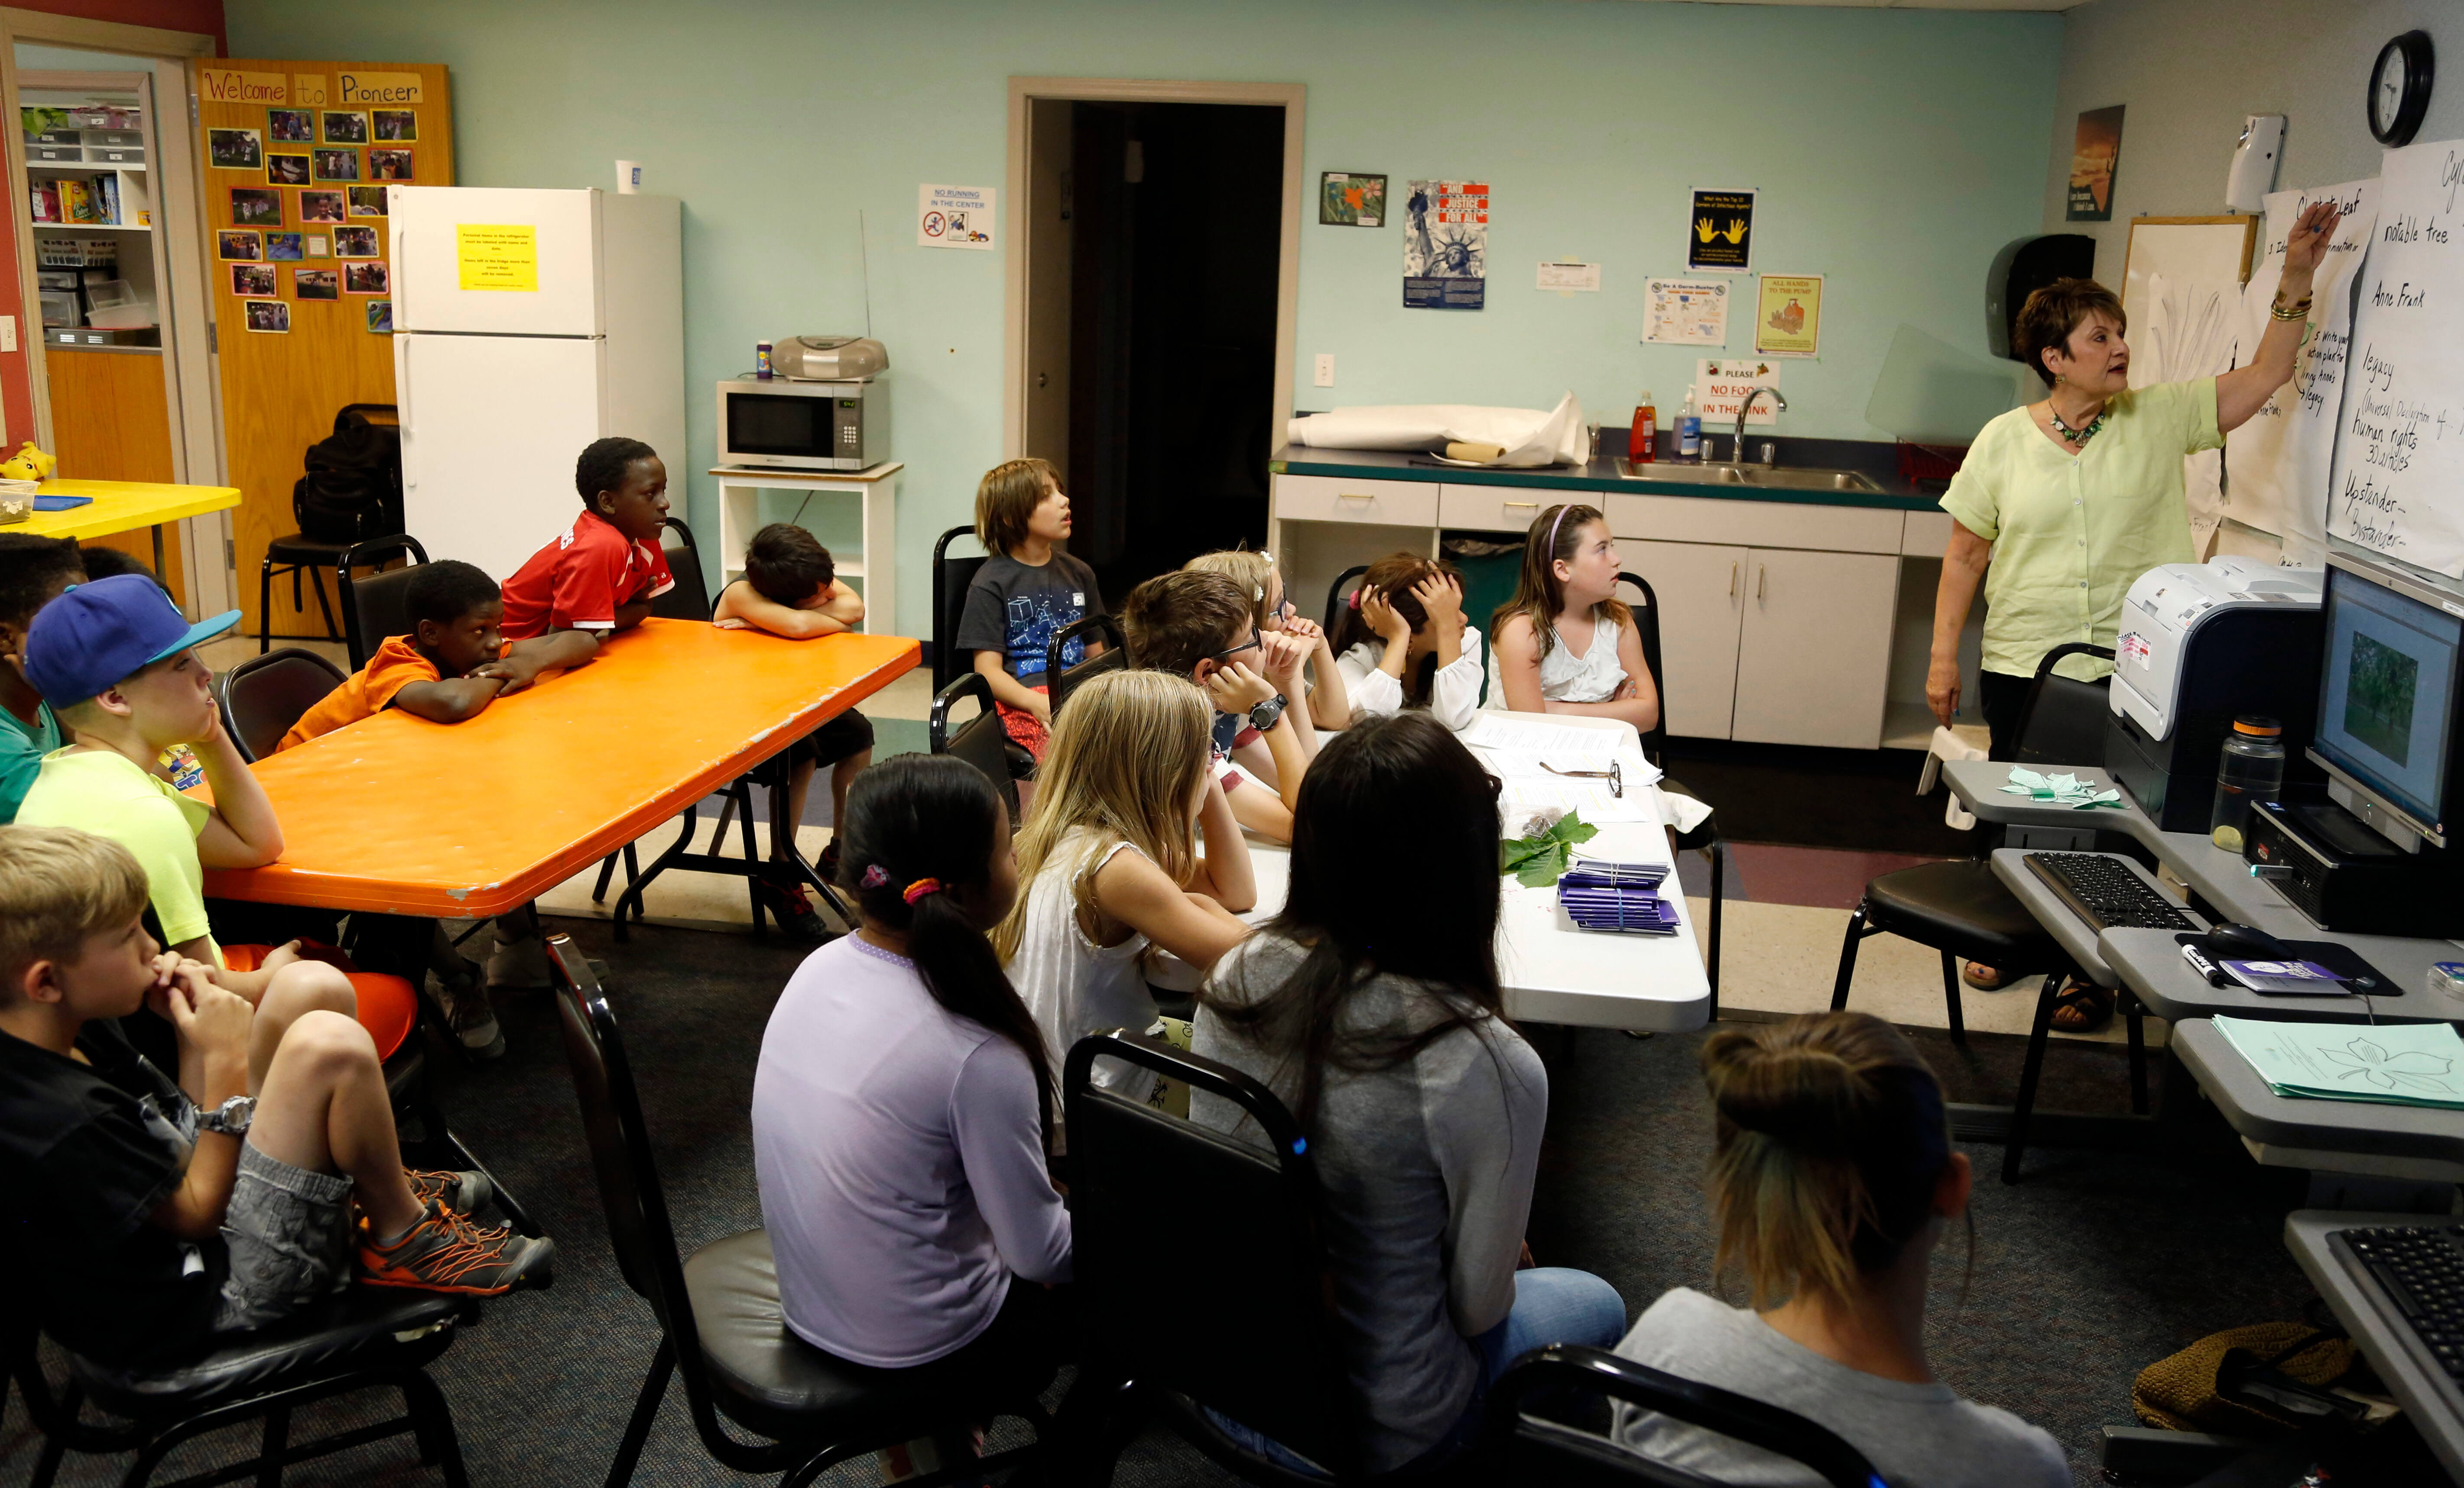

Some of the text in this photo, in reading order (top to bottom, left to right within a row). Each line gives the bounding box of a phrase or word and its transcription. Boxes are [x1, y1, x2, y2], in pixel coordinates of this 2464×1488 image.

[205, 72, 418, 104] Welcome to Pioneer
[1446, 199, 1479, 208] JUSTICE
[2336, 188, 2361, 216] Leaf
[1446, 213, 1461, 222] FOR
[2385, 214, 2448, 243] notable tree
[2372, 281, 2425, 308] Anne Frank
[2322, 331, 2337, 342] Write
[2322, 347, 2335, 366] plan
[2301, 366, 2335, 387] living Anne's
[2363, 343, 2394, 392] legacy
[1711, 385, 1762, 395] NO FOO
[1703, 404, 1768, 415] IN THE INK
[2353, 408, 2418, 457] human rights
